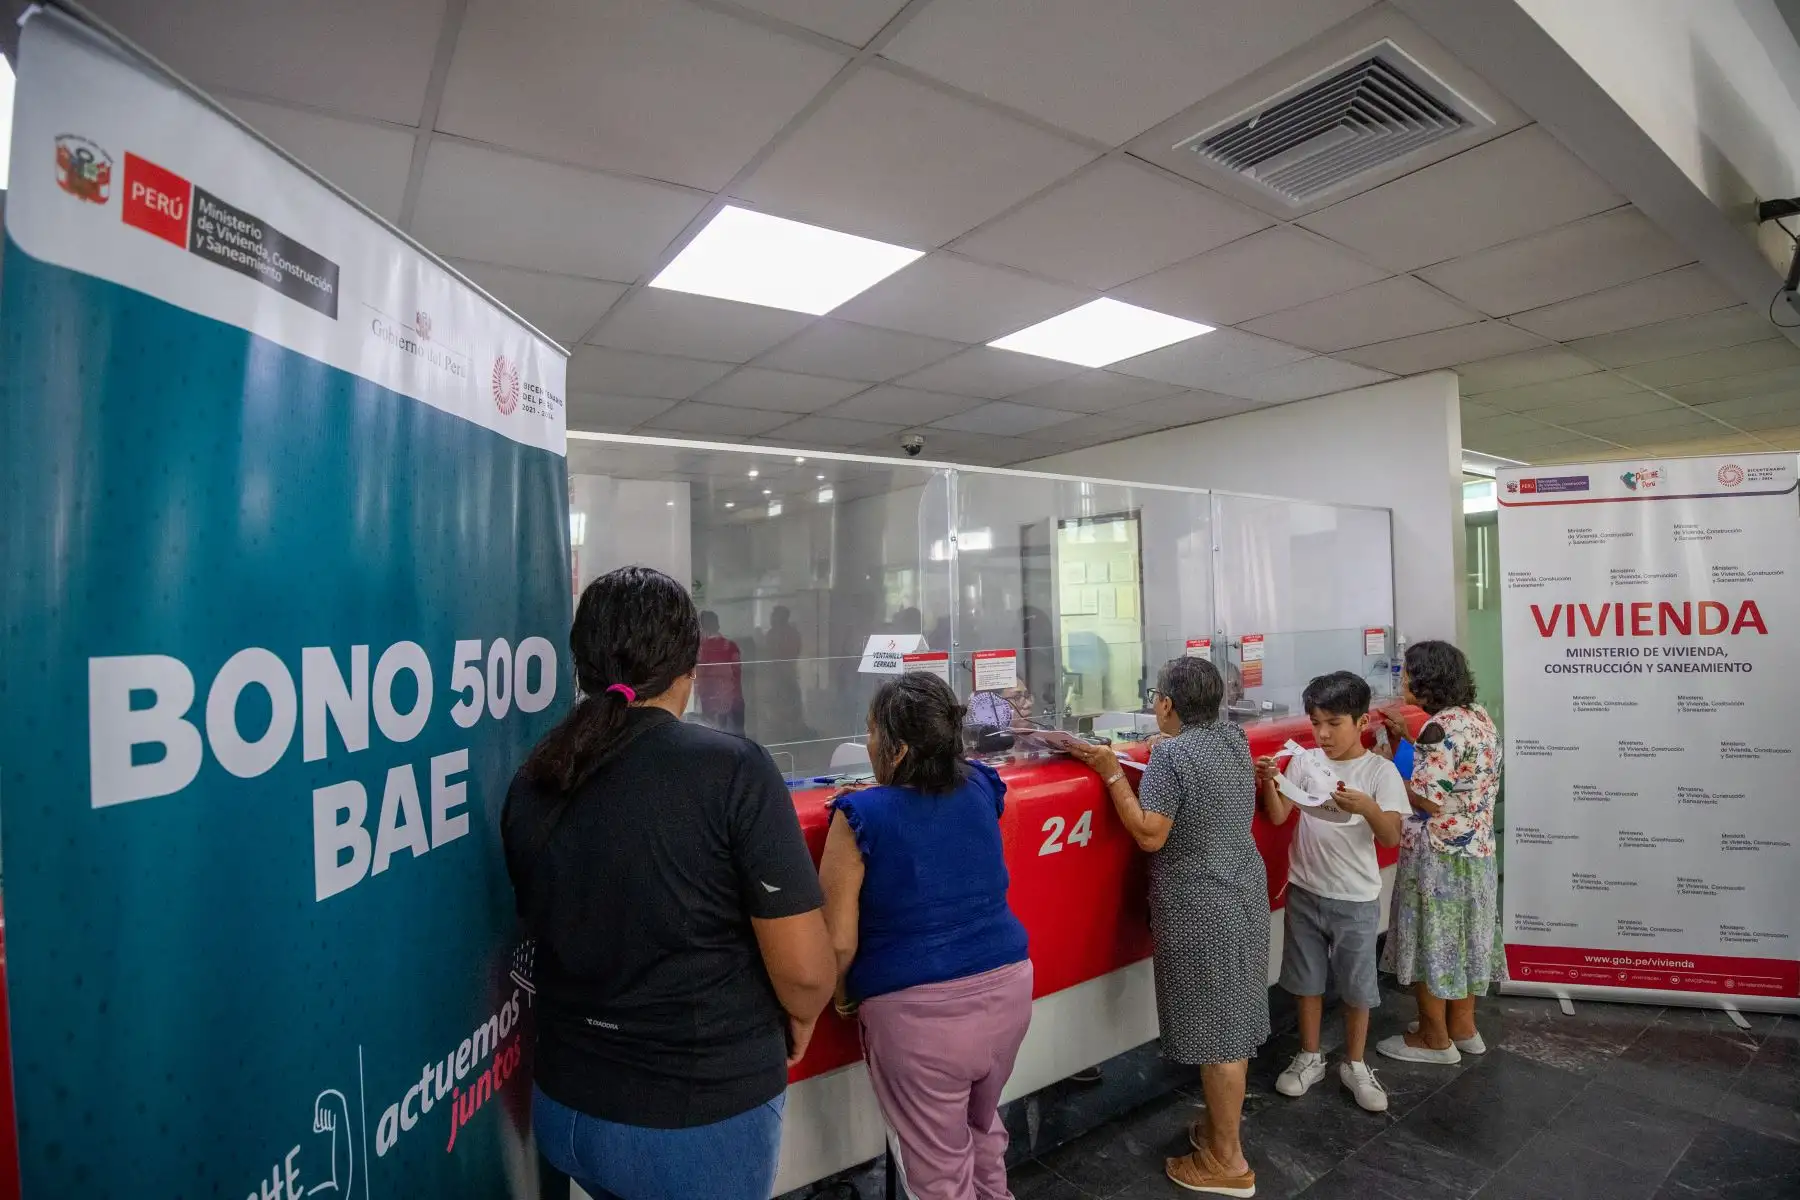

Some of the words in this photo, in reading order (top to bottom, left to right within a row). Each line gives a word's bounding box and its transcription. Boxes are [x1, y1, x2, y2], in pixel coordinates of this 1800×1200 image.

[131, 180, 183, 221] PERÚ
[199, 195, 262, 240] Ministerio
[195, 232, 204, 248] y
[206, 234, 283, 283] Saneamiento
[197, 216, 214, 234] de
[216, 223, 271, 263] Vivienda,
[271, 251, 333, 294] Construcción
[372, 318, 424, 357] Gobierno
[522, 393, 536, 404] DEL
[522, 403, 536, 414] 2021
[1529, 599, 1769, 638] VIVIENDA
[873, 660, 897, 668] CERRADA
[1544, 660, 1643, 674] CONSTRUCCIÓN
[1646, 662, 1655, 673] Y
[1656, 662, 1753, 674] SANEAMIENTO
[1566, 646, 1640, 659] MINISTERIO
[1643, 647, 1660, 658] DE
[1661, 646, 1729, 659] VIVIENDA,
[88, 640, 434, 810] BONO
[449, 636, 557, 728] 500
[312, 748, 470, 903] BAE
[1038, 809, 1093, 857] 24
[1584, 954, 1695, 969] www.gob.pe/vivienda
[592, 1019, 619, 1030] DIADORA
[375, 989, 520, 1157] actuemos
[447, 1036, 521, 1153] juntos
